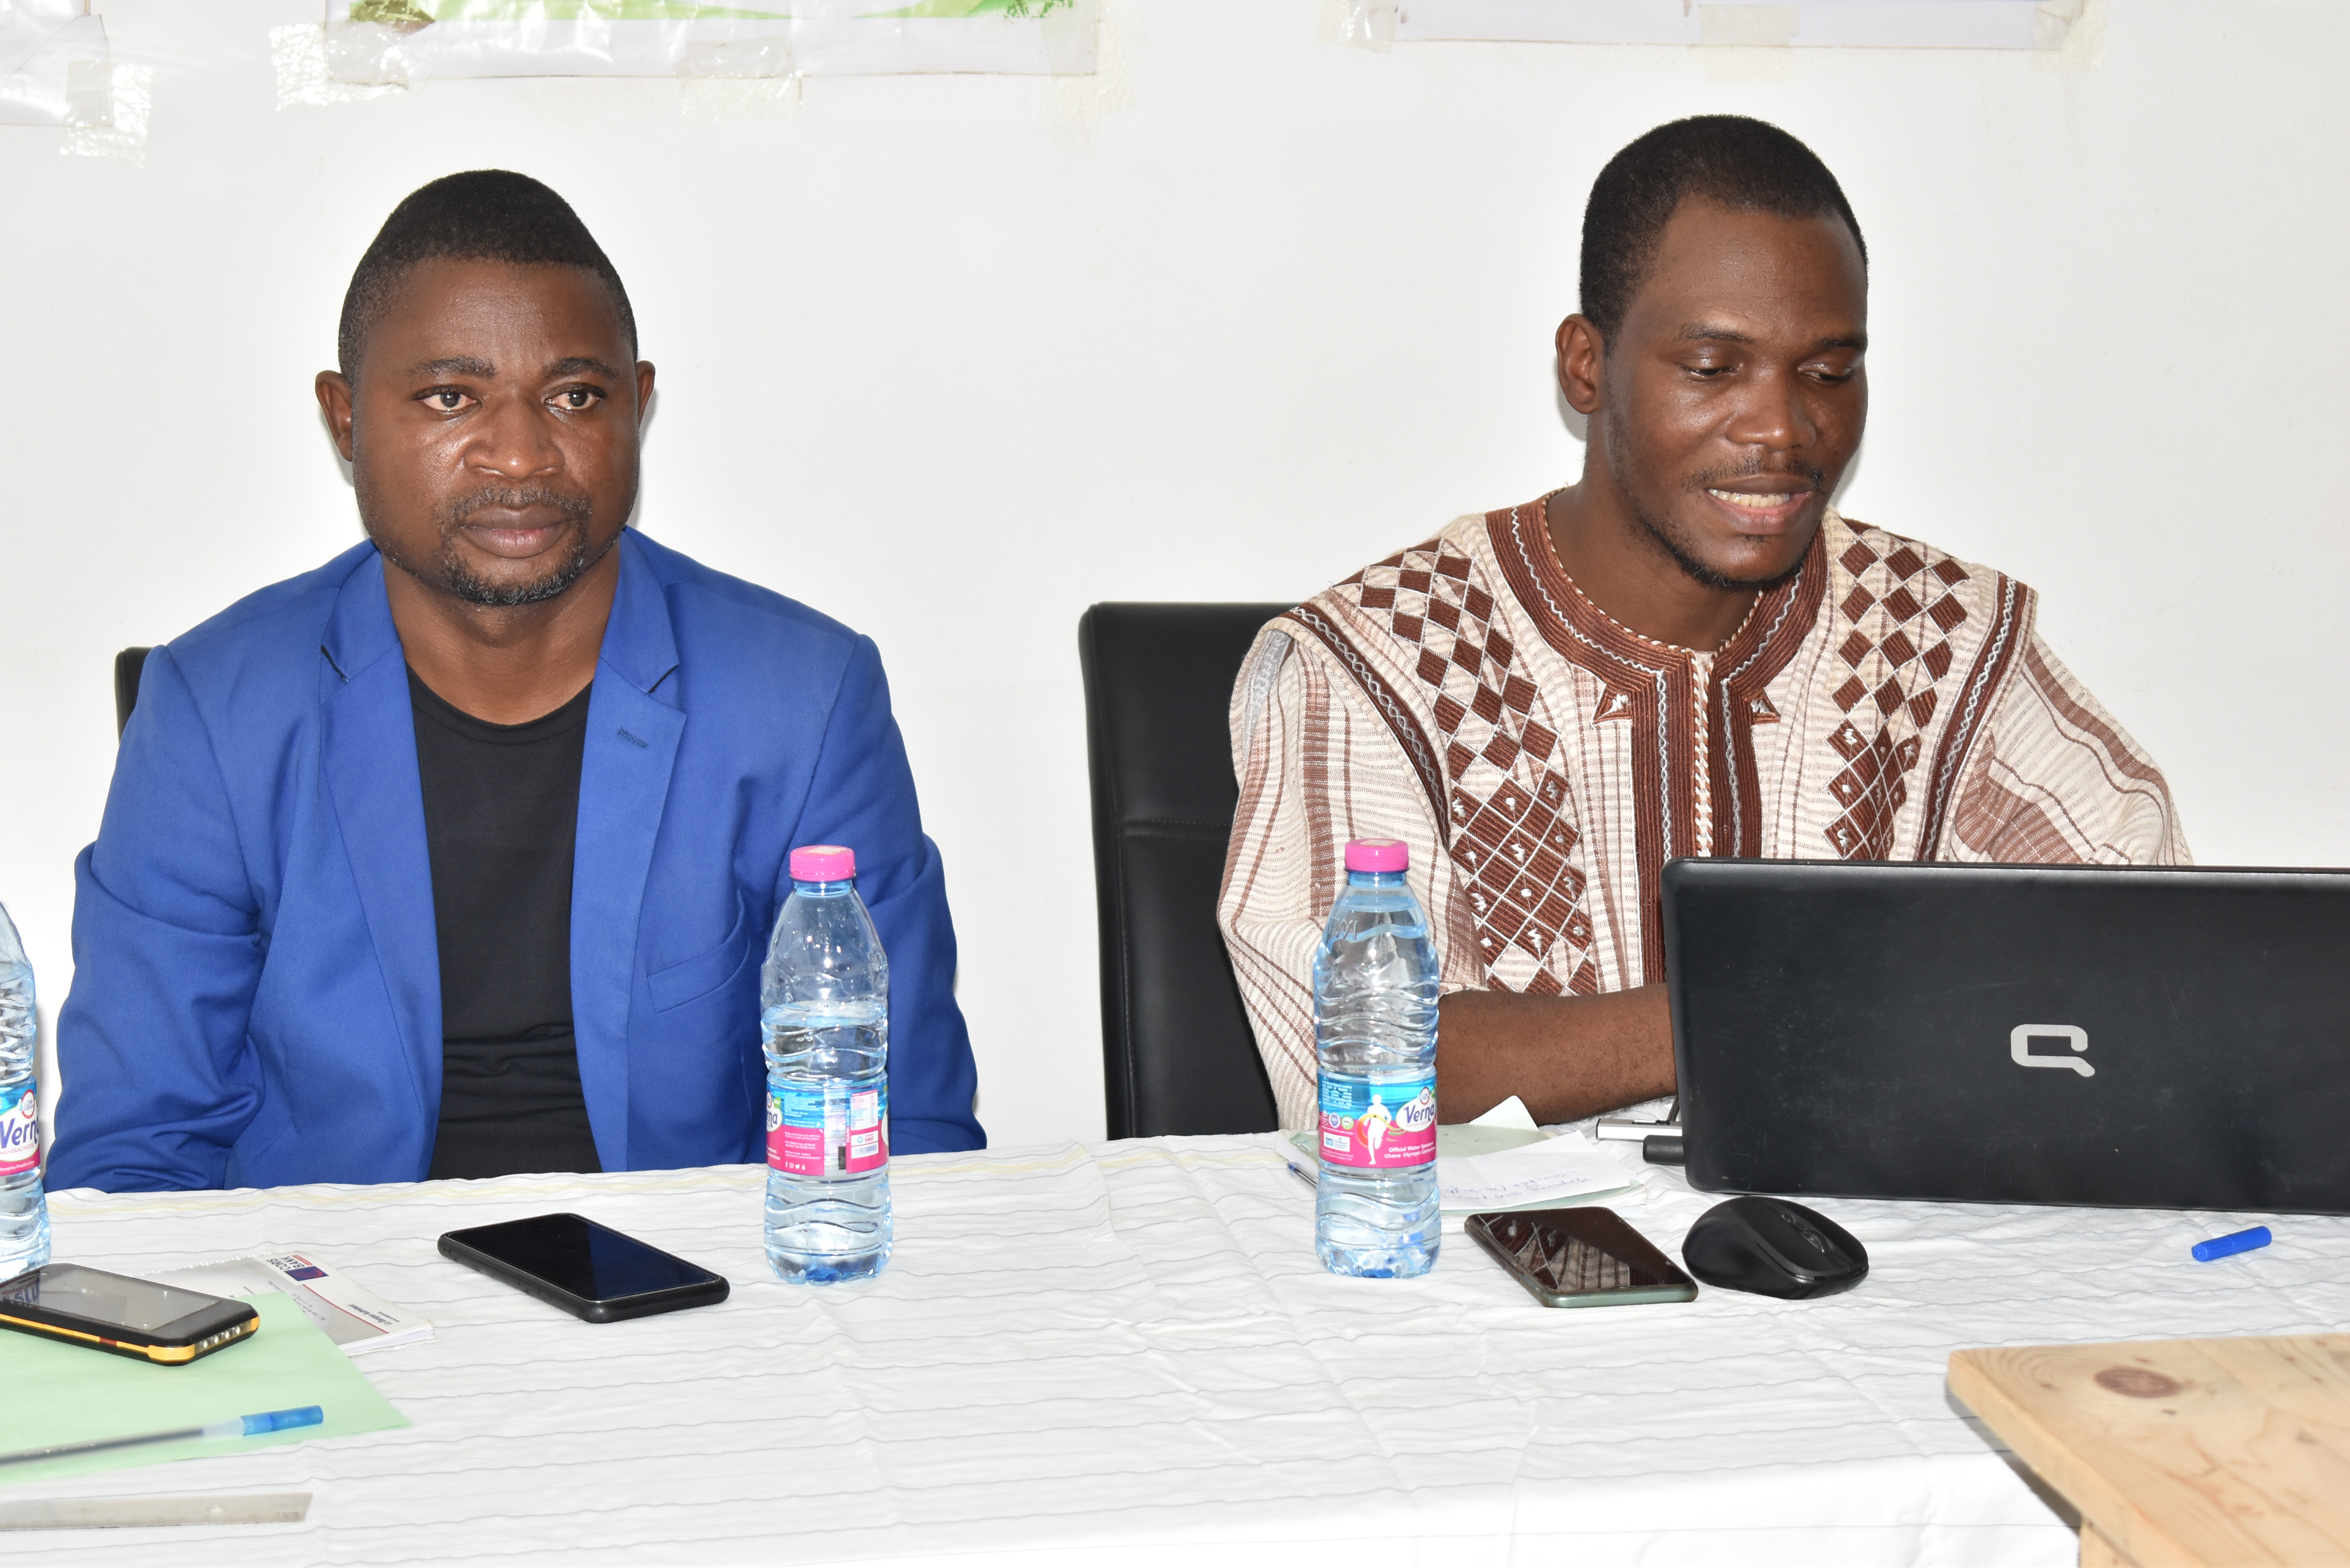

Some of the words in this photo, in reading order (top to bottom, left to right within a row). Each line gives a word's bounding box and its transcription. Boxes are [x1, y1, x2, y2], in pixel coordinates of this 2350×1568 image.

[1403, 1104, 1435, 1124] Verna
[0, 1147, 22, 1155] MINERAL
[267, 1258, 291, 1270] CORIS
[279, 1256, 305, 1268] BANK
